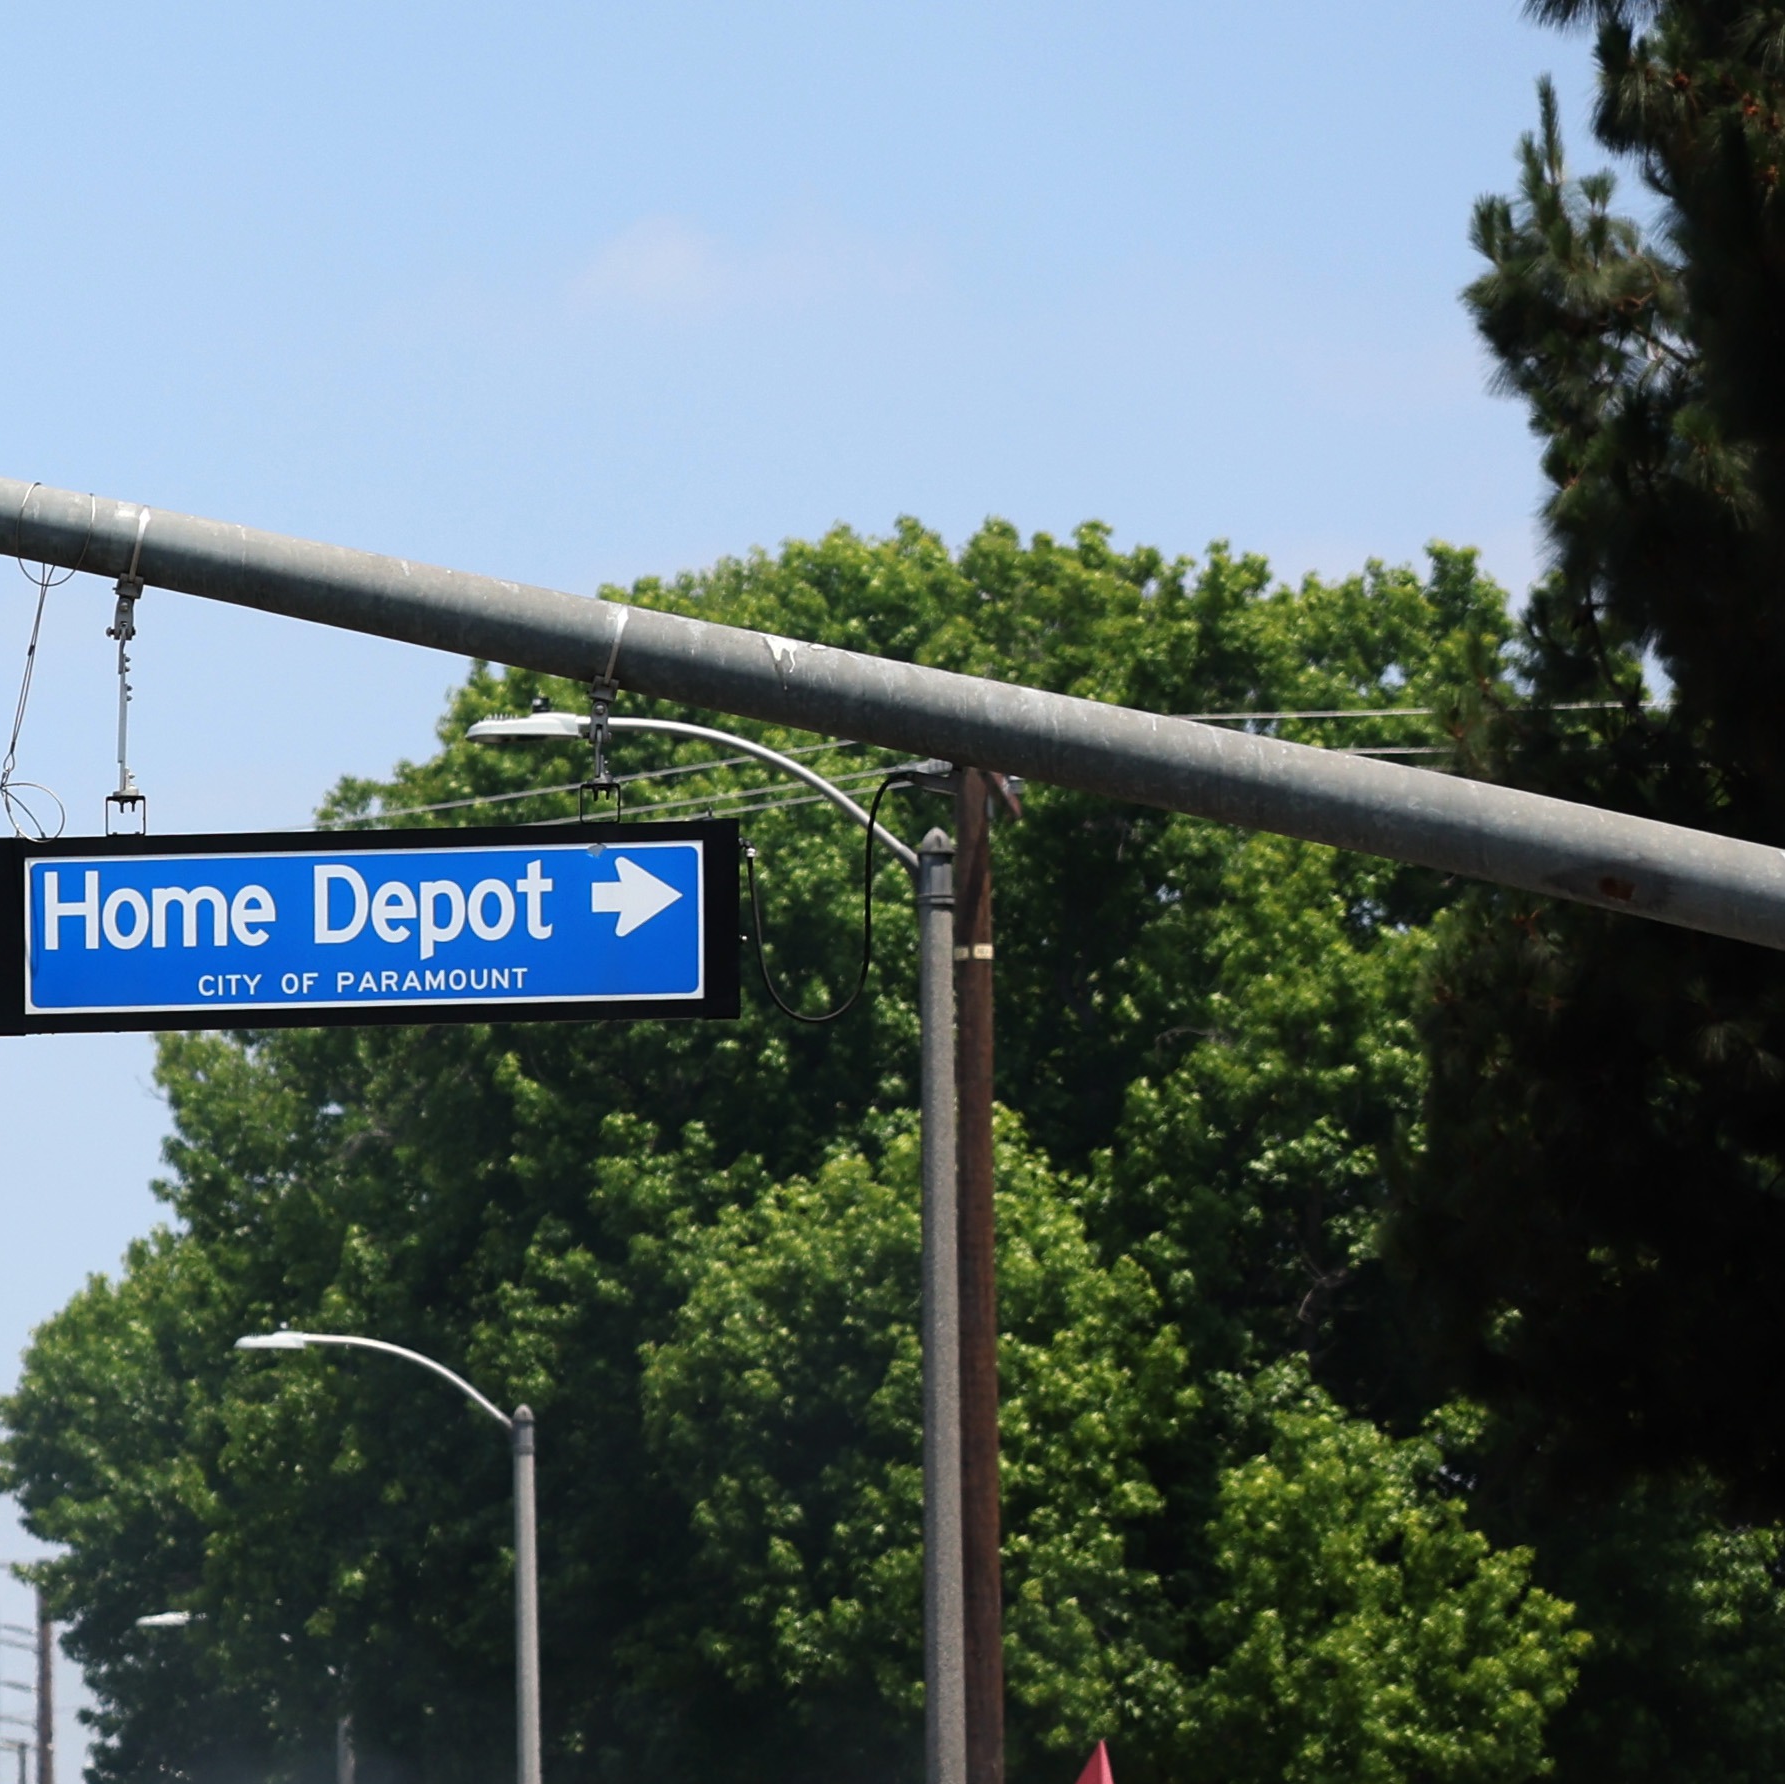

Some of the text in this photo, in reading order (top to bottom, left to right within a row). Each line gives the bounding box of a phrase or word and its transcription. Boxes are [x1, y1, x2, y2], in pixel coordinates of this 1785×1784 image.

[44, 858, 553, 961] Home Depot
[197, 967, 528, 997] CITY OF PARAMOUNT
